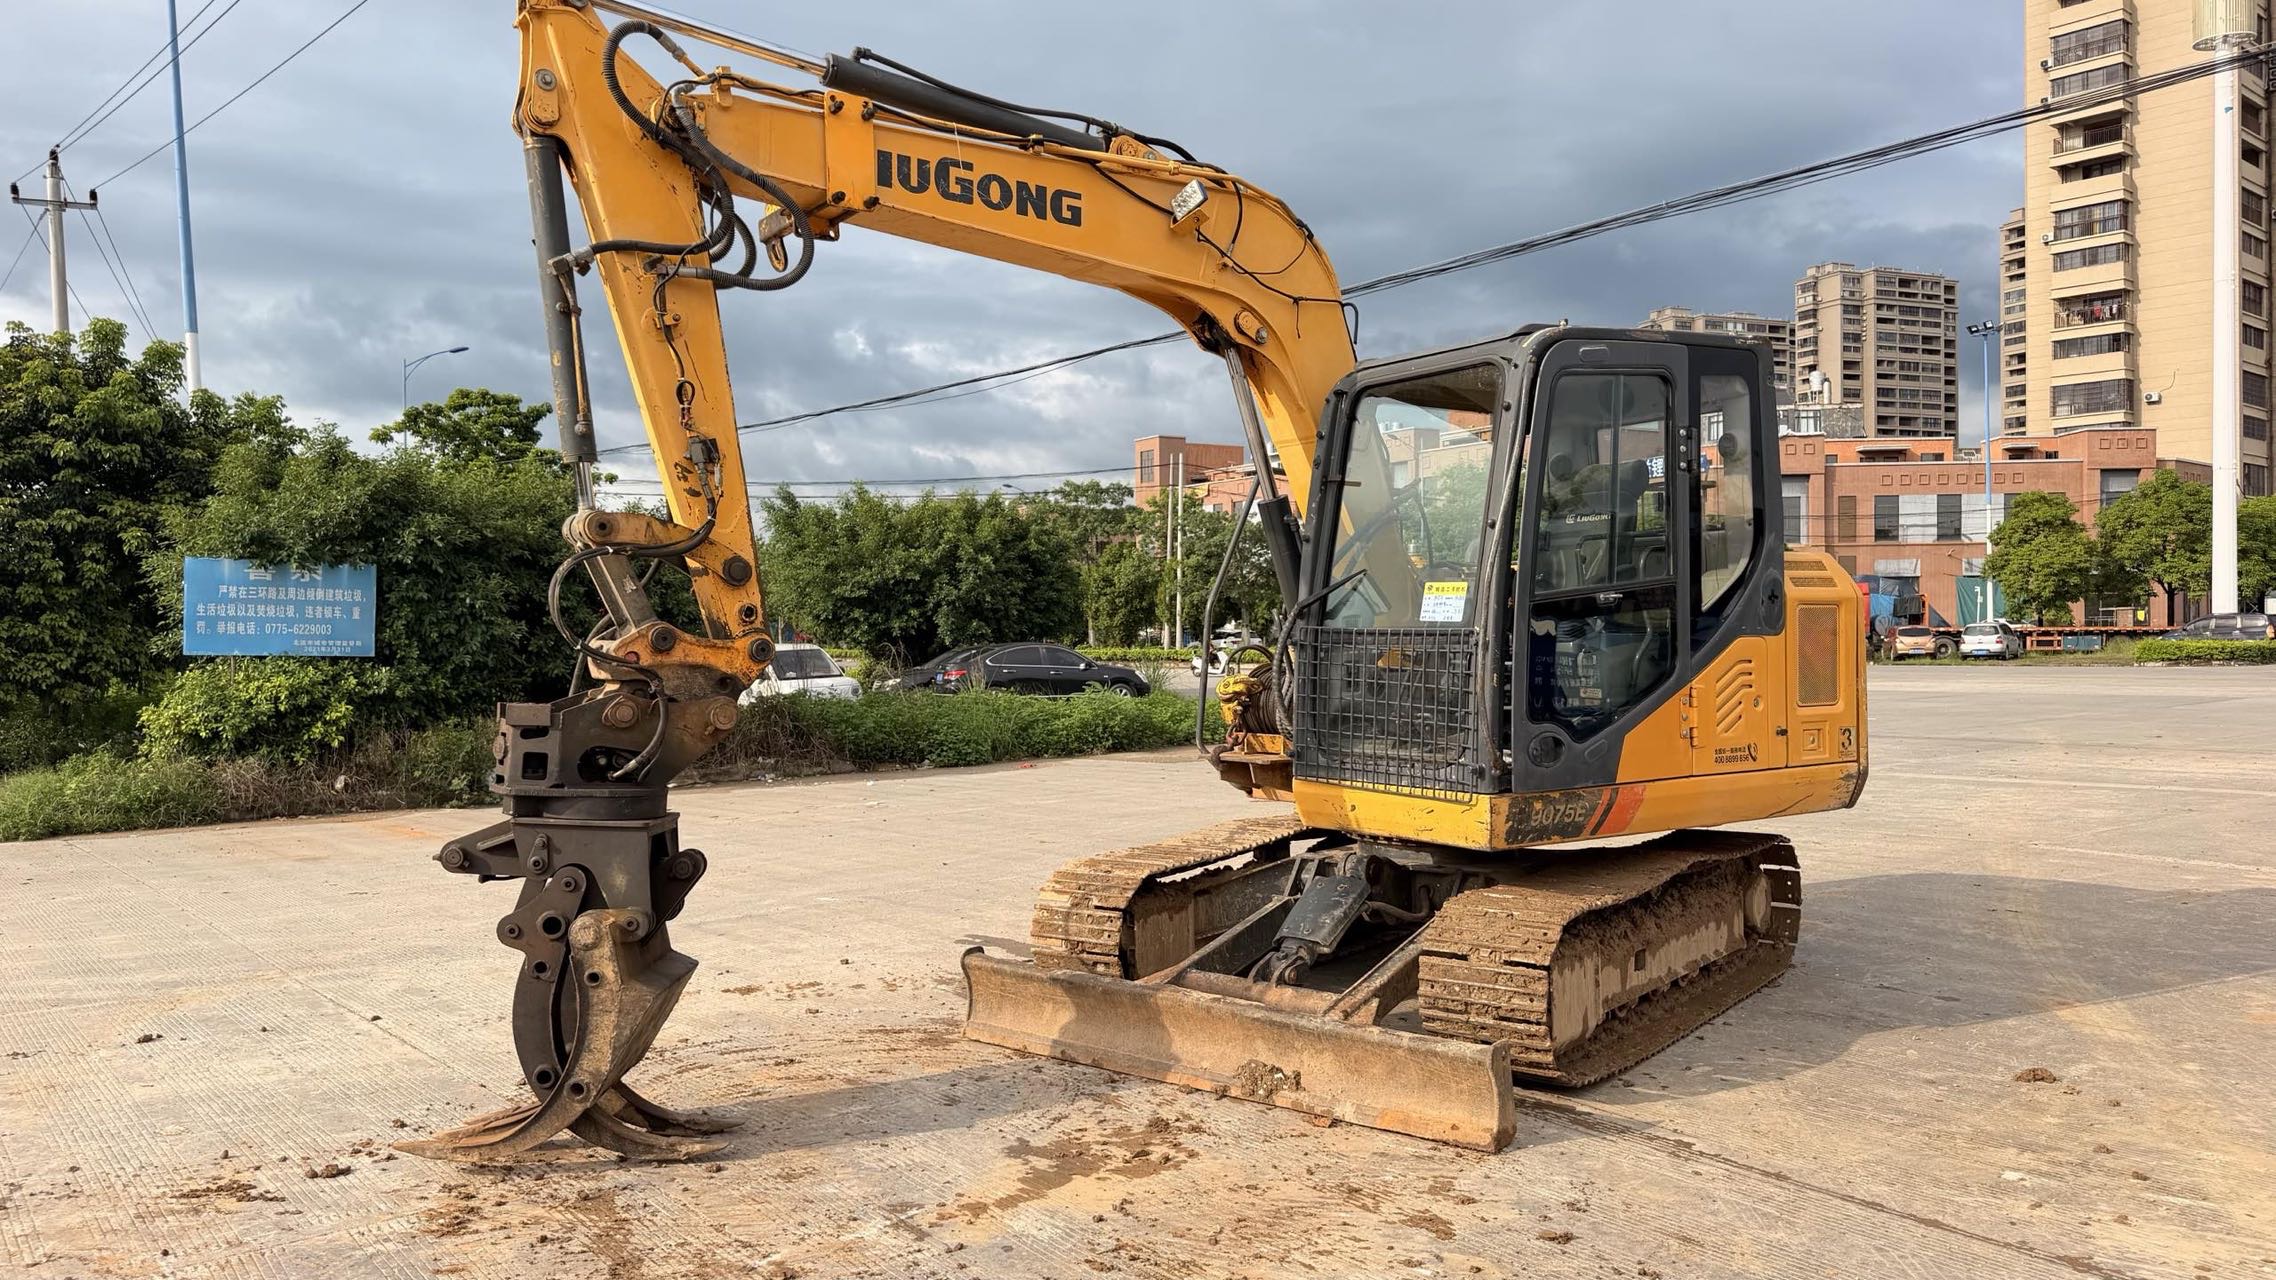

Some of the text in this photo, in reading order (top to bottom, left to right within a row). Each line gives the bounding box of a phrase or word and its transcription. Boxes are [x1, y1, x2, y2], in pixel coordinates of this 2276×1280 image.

[877, 149, 1082, 227] IUGONG
[1841, 727, 1852, 751] 3
[1530, 801, 1586, 827] 9075E
